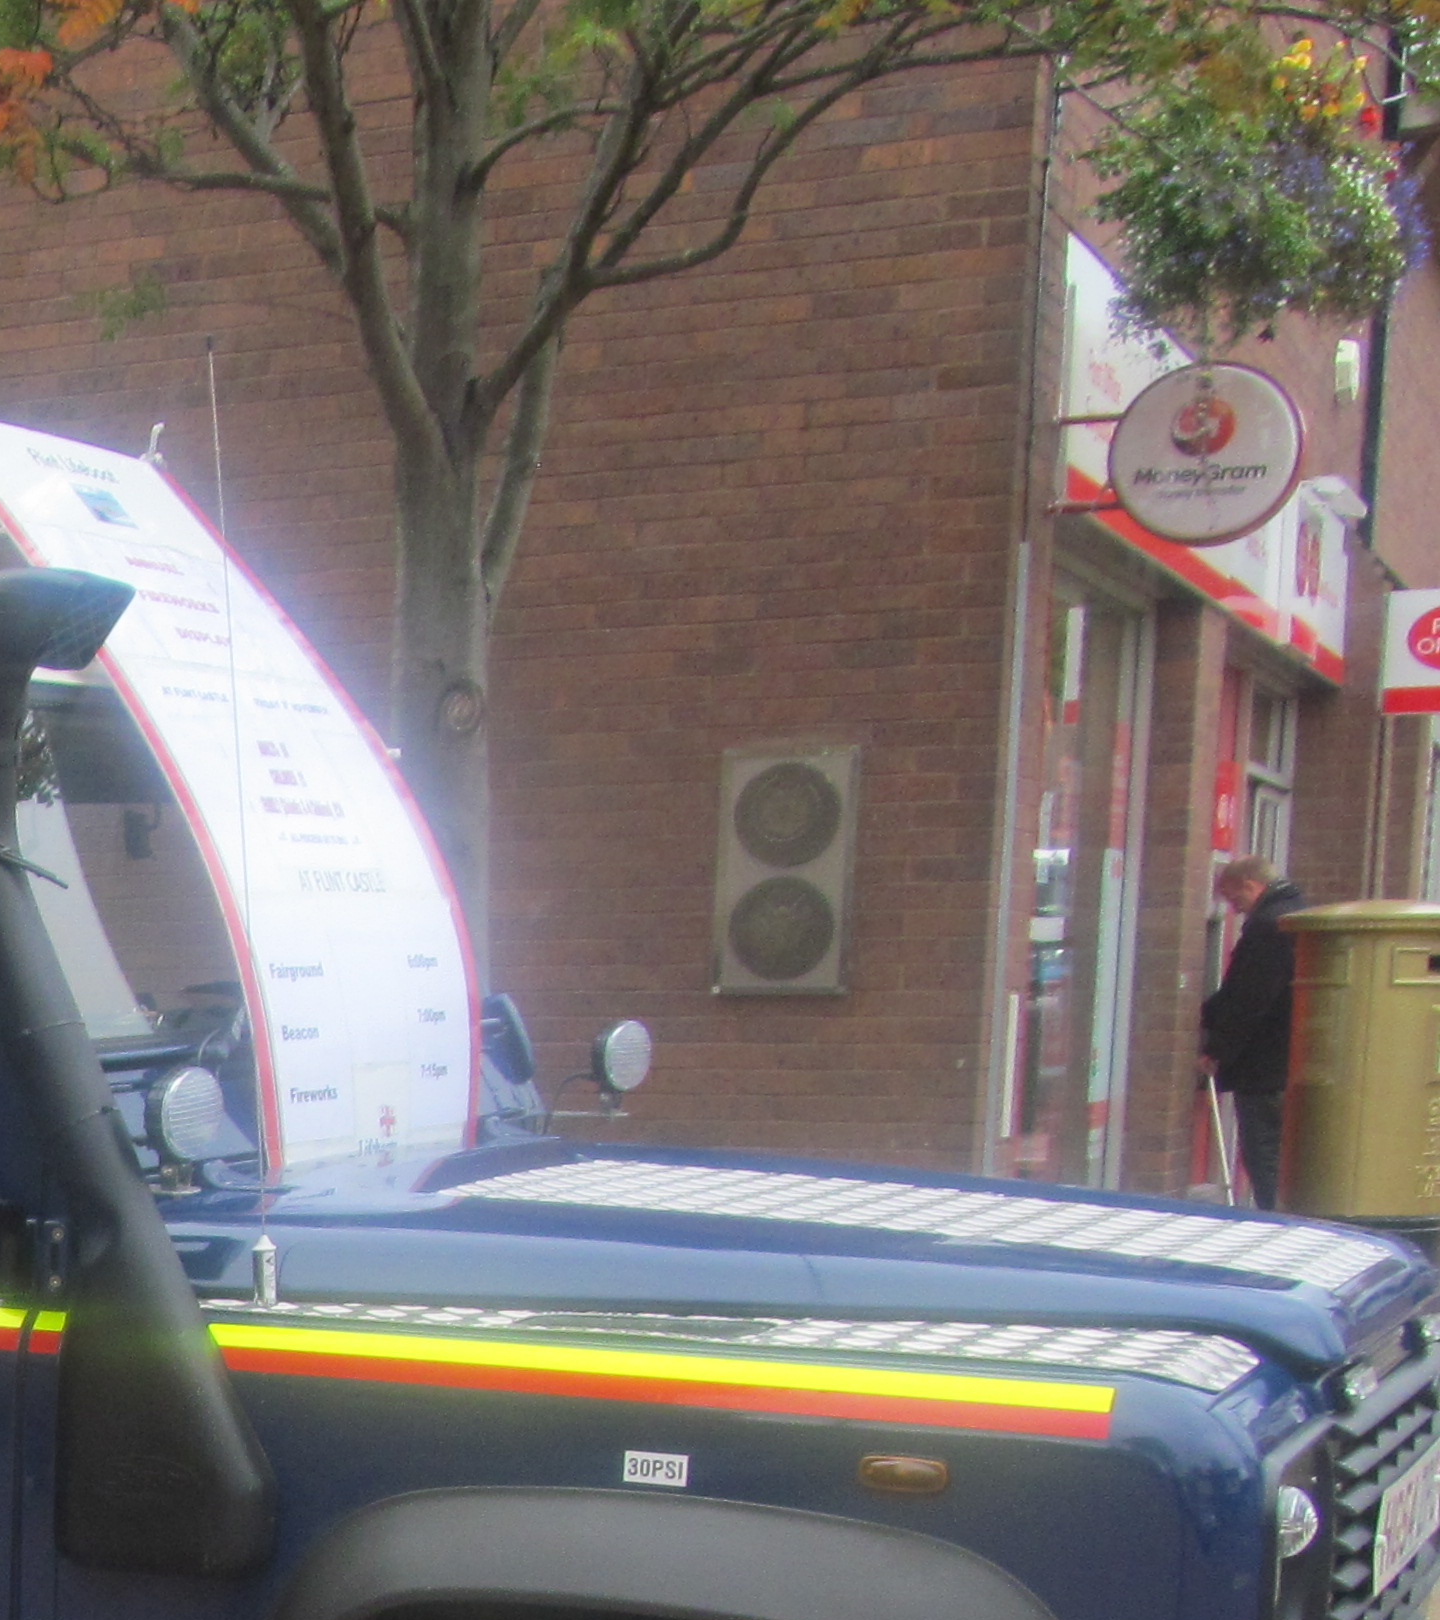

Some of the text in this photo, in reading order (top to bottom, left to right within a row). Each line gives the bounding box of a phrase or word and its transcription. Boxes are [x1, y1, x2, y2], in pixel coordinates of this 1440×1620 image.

[269, 962, 324, 982] Fairground
[281, 1025, 320, 1041] Beacon
[290, 1085, 338, 1104] Fireworks
[628, 1458, 684, 1480] 30PSI
